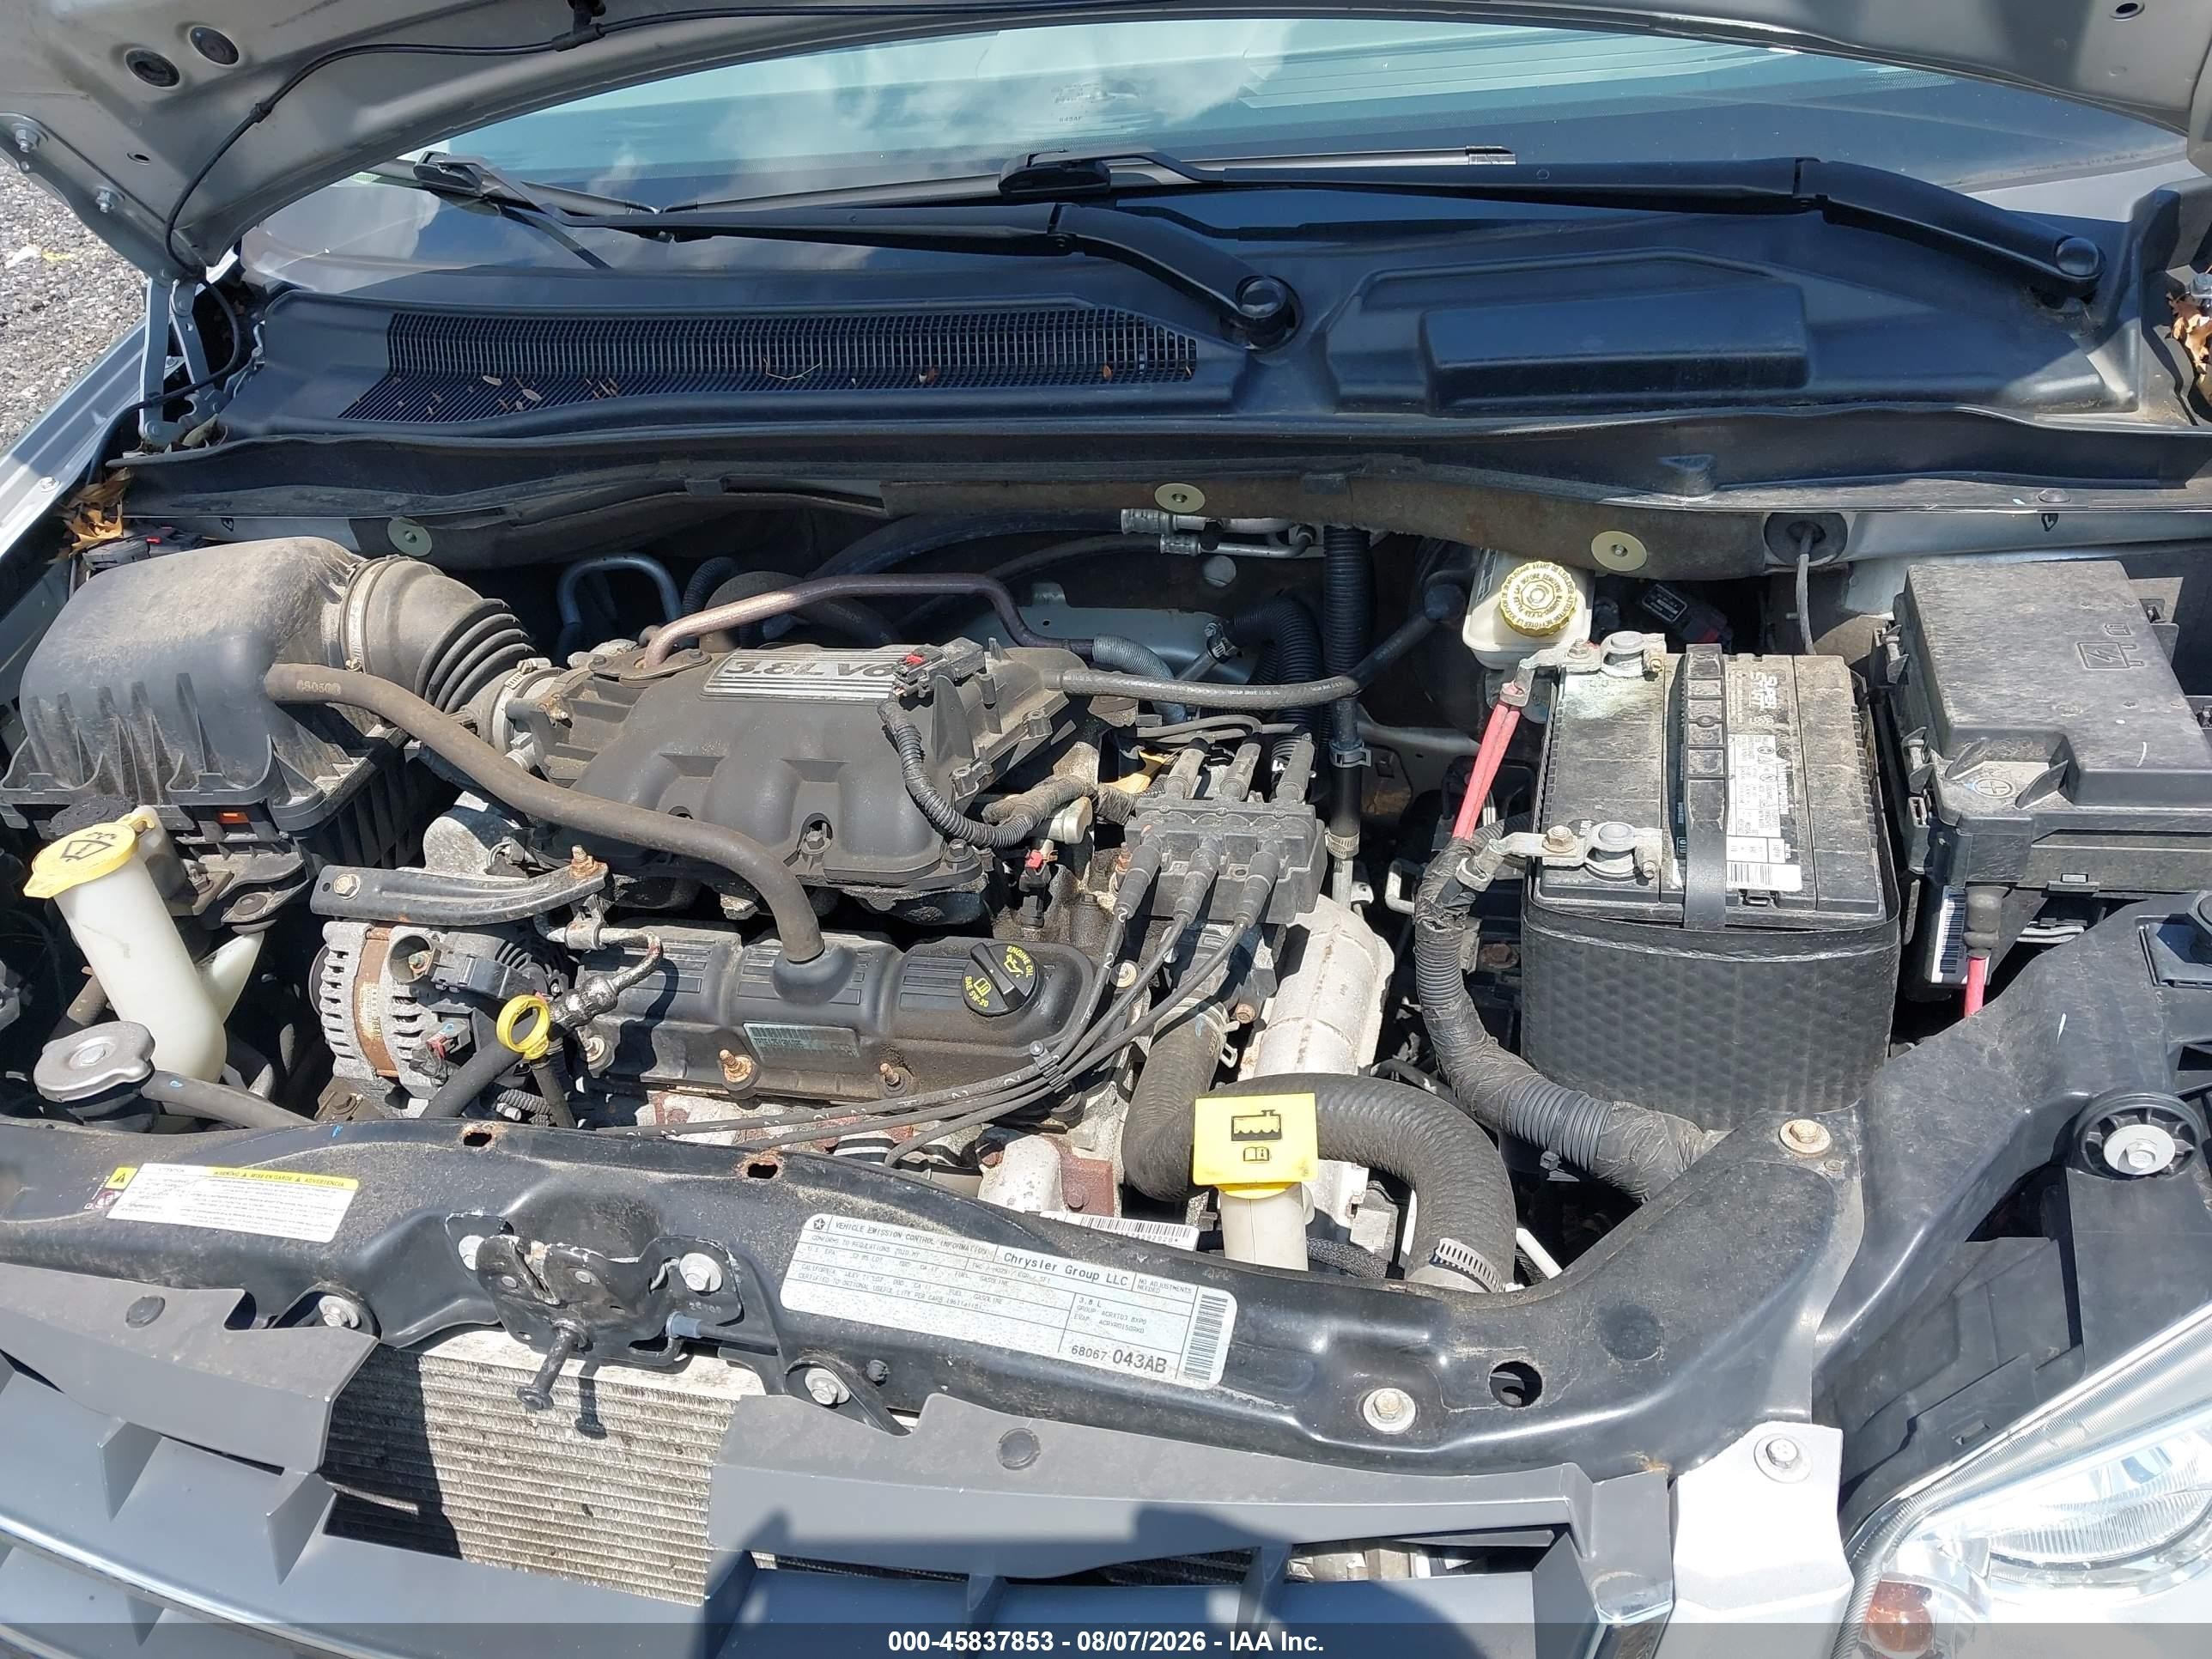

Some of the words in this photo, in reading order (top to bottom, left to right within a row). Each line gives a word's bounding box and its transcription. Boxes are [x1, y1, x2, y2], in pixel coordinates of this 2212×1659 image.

[725, 661, 824, 675] 3.8L
[838, 663, 896, 677] V6
[1006, 946, 1030, 965] ENGINE
[969, 990, 989, 1007] 5W-20
[835, 1220, 865, 1233] VEHICLE
[866, 1225, 902, 1240] EMISSION
[904, 1232, 937, 1245] CONTROL
[939, 1239, 988, 1255] INFORMATION
[1002, 1252, 1058, 1271] Chrysler
[1064, 1264, 1101, 1281] Group
[1105, 1273, 1128, 1285] LLC
[1136, 1284, 1160, 1293] NEEDED
[1149, 1280, 1192, 1293] ADJUSTMENTS
[1079, 1297, 1093, 1305] 3.8
[1070, 1344, 1108, 1361] 68067
[1111, 1348, 1168, 1374] 043AB
